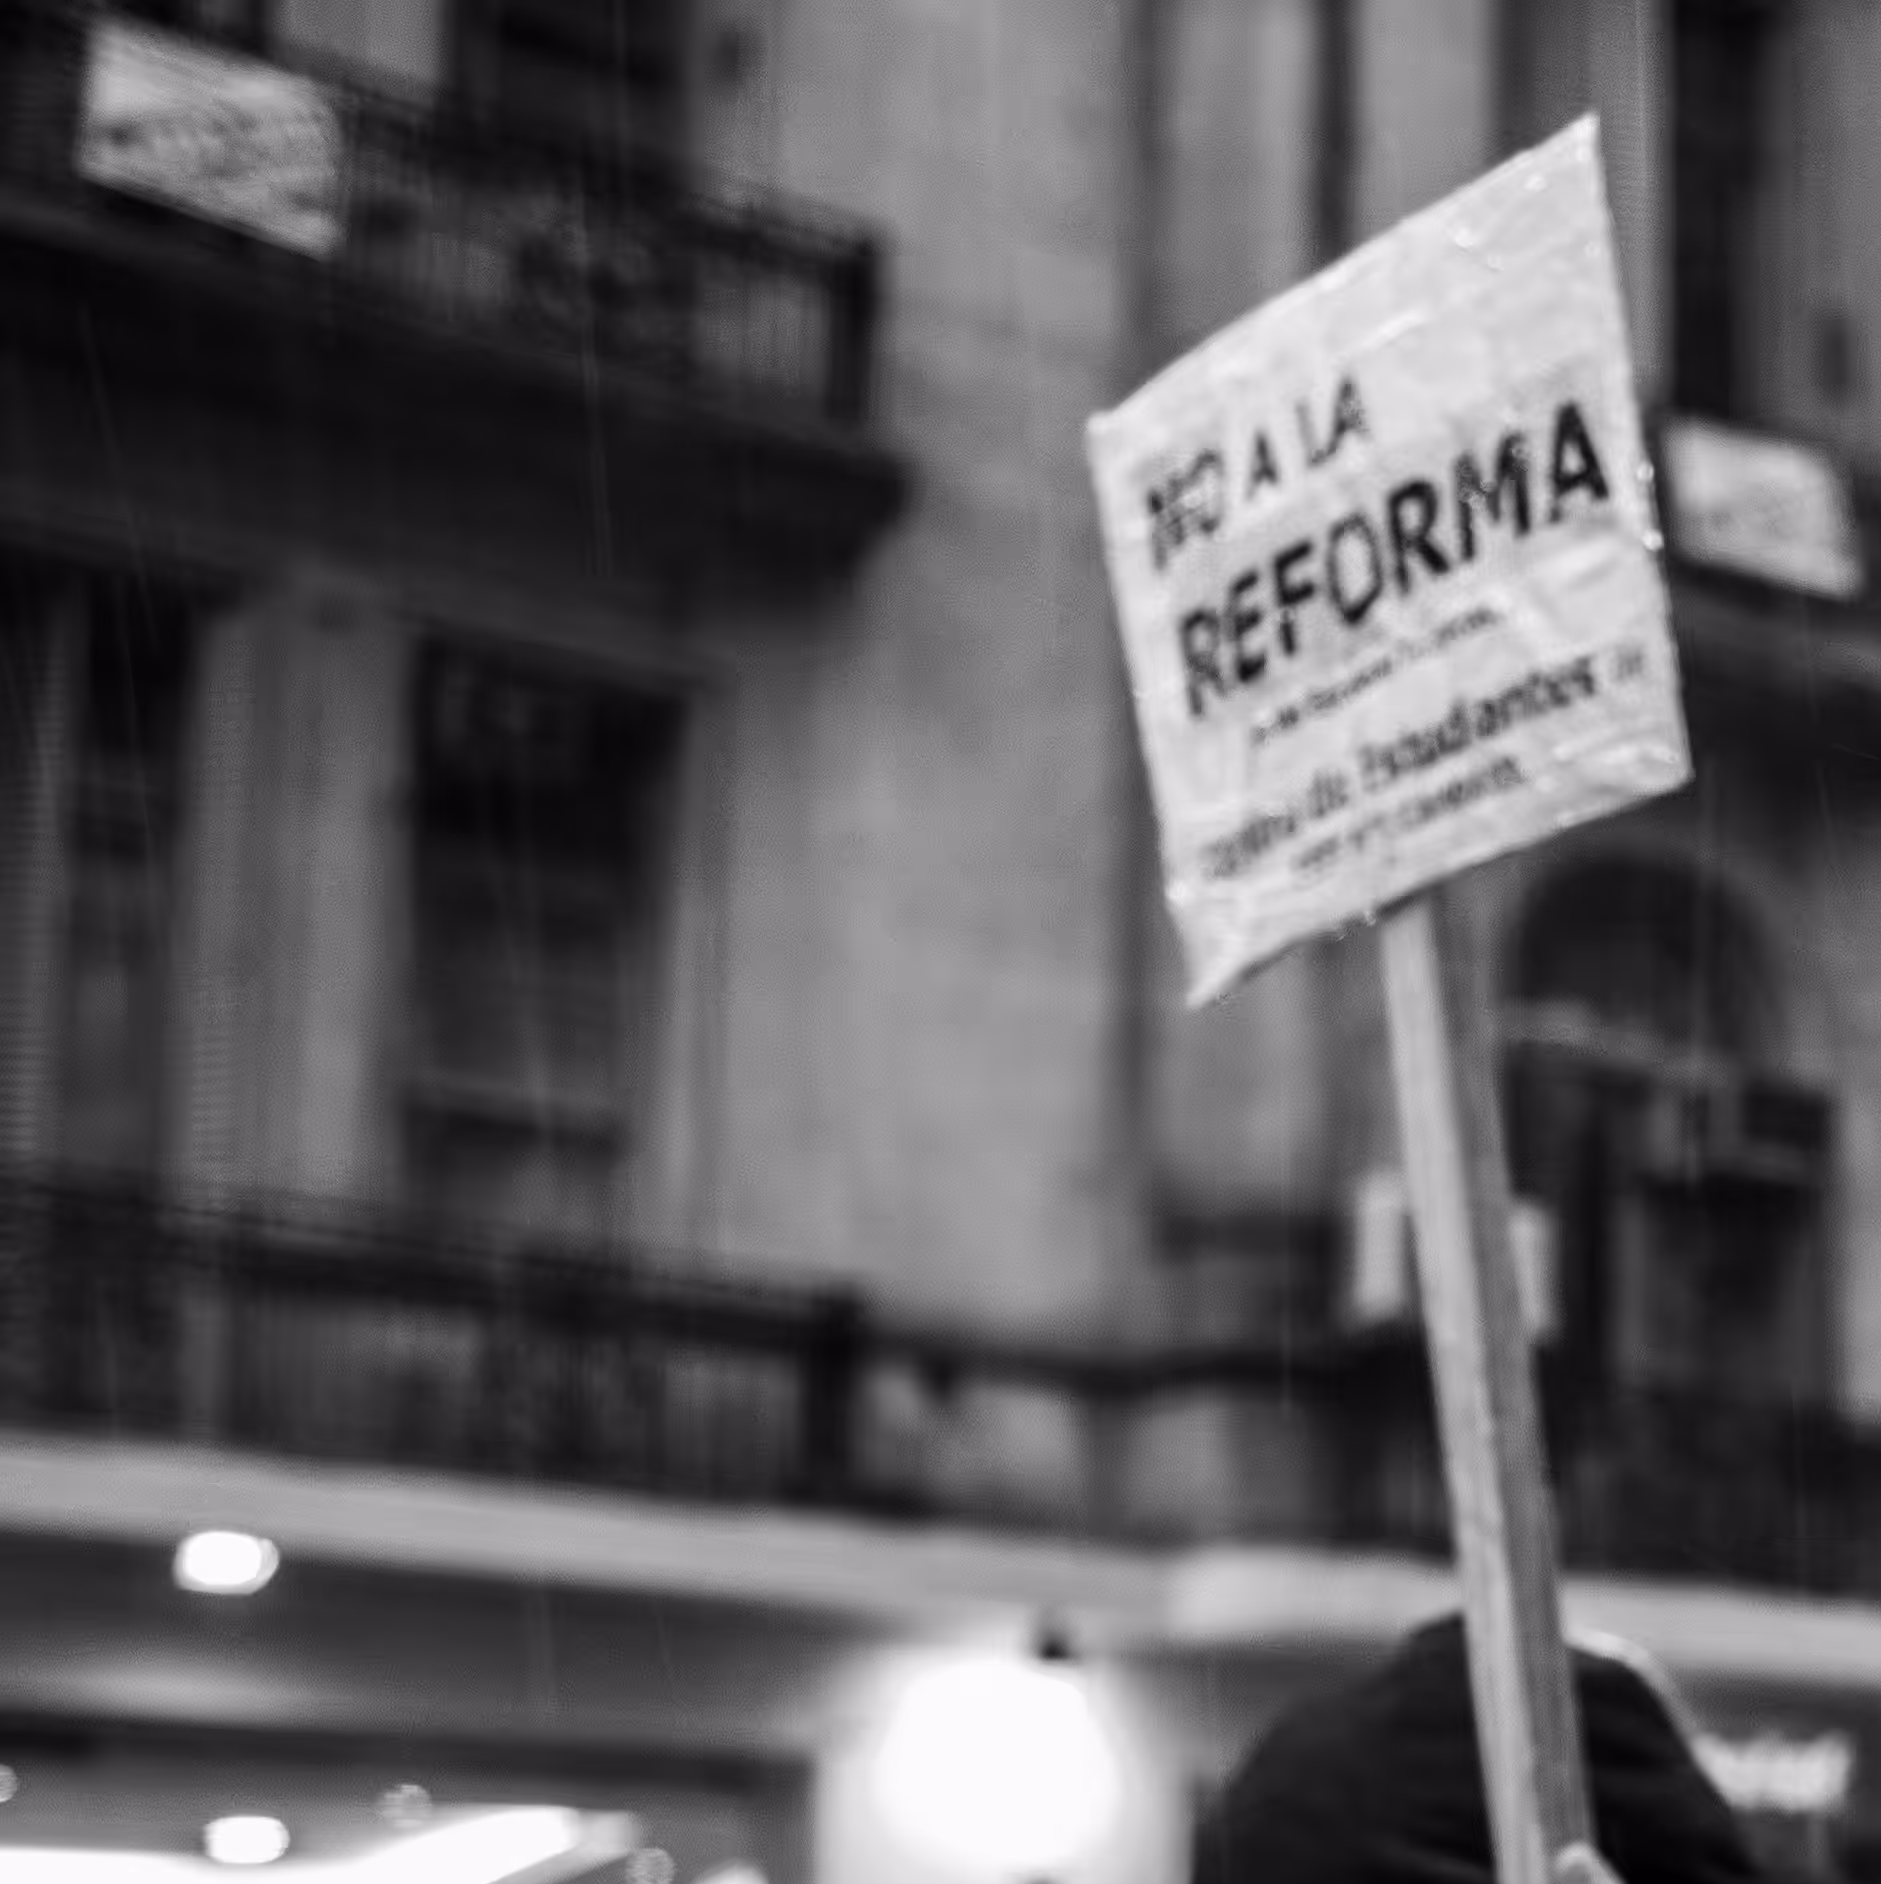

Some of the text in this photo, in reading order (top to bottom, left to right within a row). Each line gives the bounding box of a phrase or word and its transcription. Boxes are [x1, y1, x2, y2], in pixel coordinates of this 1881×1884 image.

[1146, 373, 1368, 570] NO A LA
[1179, 400, 1612, 720] REFORMA
